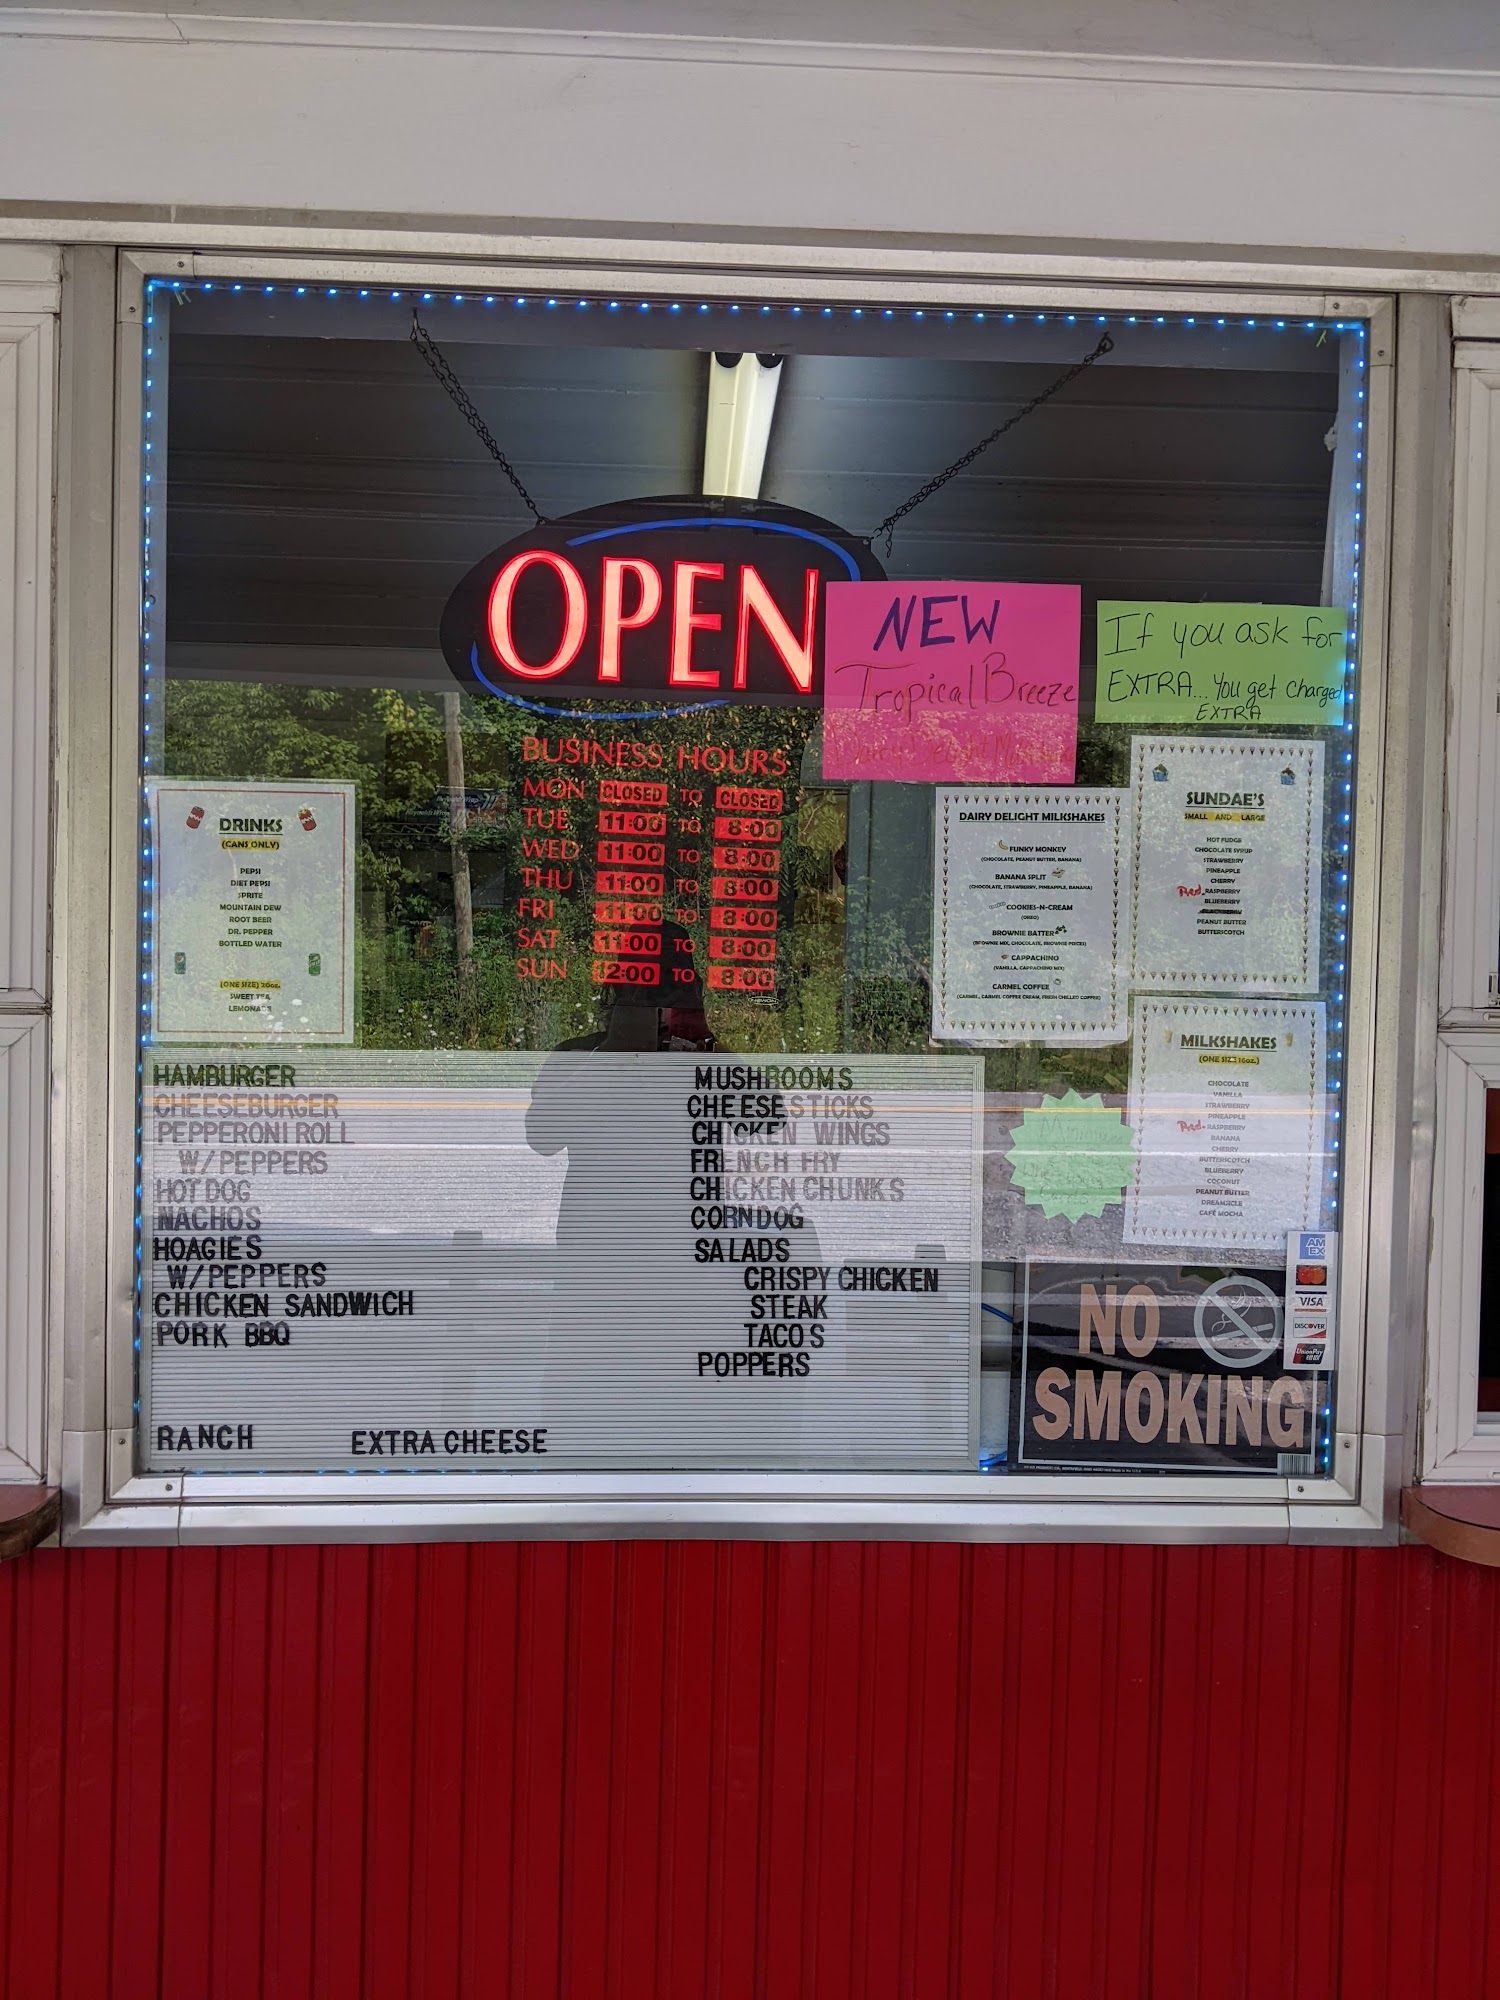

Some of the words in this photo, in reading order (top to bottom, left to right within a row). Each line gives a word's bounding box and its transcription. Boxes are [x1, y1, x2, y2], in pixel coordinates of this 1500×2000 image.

[488, 550, 819, 693] OPEN
[873, 595, 1000, 652] NEW
[1105, 612, 1154, 656] If
[1174, 622, 1224, 658] you
[1236, 617, 1288, 645] ask
[1302, 616, 1342, 648] for
[835, 663, 977, 724] Tropical
[983, 652, 1077, 707] Breeze
[1247, 674, 1275, 709] get
[1196, 704, 1261, 720] EXTRA
[523, 736, 662, 768] BUSINESS
[678, 746, 786, 776] HOURS
[523, 777, 584, 799] MON
[602, 784, 662, 801] CLOSED
[680, 789, 702, 802] TO
[720, 791, 778, 808] CLOSED
[1186, 792, 1265, 806] SUNDAE'S
[219, 818, 283, 832] DRINKS
[523, 808, 570, 830] TUE
[605, 813, 662, 832] 11:00
[679, 819, 701, 832] TO
[728, 820, 778, 838] 8:00
[959, 813, 991, 821] DAIRY
[995, 813, 1039, 821] DELIGHT
[1042, 813, 1105, 821] MILKSHAKES
[222, 840, 249, 849] (CANS
[251, 840, 279, 850] ONLY)
[521, 838, 579, 860] WED
[604, 843, 661, 862] 11:00
[678, 849, 700, 863] TO
[725, 849, 775, 867] 8:00
[521, 868, 573, 890] THU
[606, 874, 659, 892] 11:00
[676, 879, 698, 893] TO
[724, 880, 772, 896] 8:00
[518, 898, 554, 919] FRI
[605, 905, 661, 921] 11:00
[675, 909, 698, 922] TO
[723, 910, 774, 927] 8:00
[518, 927, 560, 949] SAT
[601, 934, 658, 951] 11:00
[674, 939, 696, 952] TO
[722, 939, 771, 957] 8:00
[516, 958, 568, 980] SUN
[672, 968, 695, 982] TO
[721, 969, 771, 986] 8:00
[1181, 1035, 1277, 1049] MILKSHAKES
[1199, 1055, 1219, 1063] (ONE
[154, 1064, 296, 1087] HAMBURGER
[695, 1065, 853, 1091] MUSHROOMS
[155, 1093, 339, 1119] CHEESEBURGER
[158, 1121, 288, 1144] PEPPERONI
[296, 1121, 354, 1144] ROLL
[692, 1121, 797, 1146] CHICKEN
[813, 1121, 891, 1147] WINGS
[692, 1148, 788, 1173] FRENCH
[801, 1150, 841, 1173] FRY
[156, 1179, 200, 1203] HOT
[206, 1179, 250, 1203] DOG
[691, 1176, 796, 1201] CHICKEN
[803, 1177, 904, 1202] CHUNKS
[158, 1205, 262, 1231] NACHOS
[154, 1234, 262, 1261] HOAGIES
[695, 1238, 790, 1263] SALADS
[744, 1266, 830, 1291] CRISPY
[838, 1266, 938, 1292] CHICKEN
[155, 1292, 269, 1318] CHICKEN
[285, 1290, 414, 1317] SANDWICH
[751, 1295, 828, 1319] STEAK
[1300, 1297, 1323, 1306] VISA
[1079, 1283, 1160, 1358] NO
[156, 1321, 228, 1348] PORK
[245, 1321, 291, 1347] BBQ
[744, 1324, 824, 1348] TACOS
[698, 1352, 810, 1377] POPPERS
[1032, 1367, 1305, 1448] SMOKING
[157, 1424, 254, 1451] RANCH
[352, 1430, 435, 1455] EXTRA
[444, 1428, 548, 1454] CHEESE
